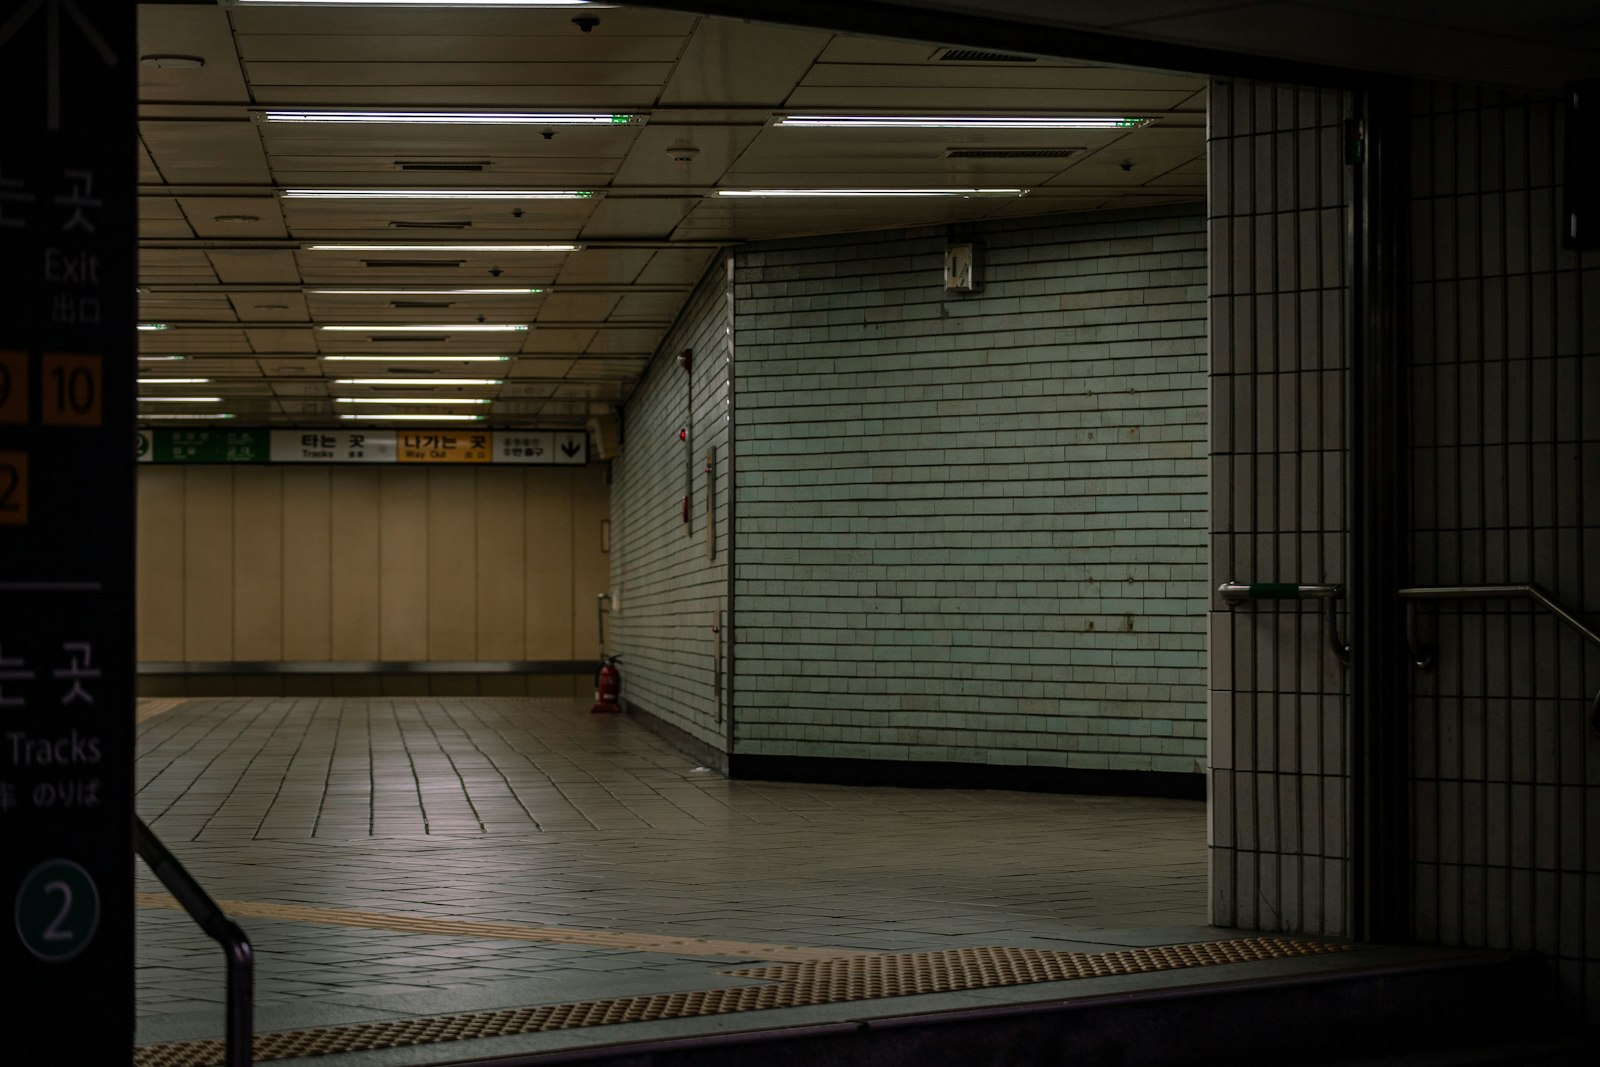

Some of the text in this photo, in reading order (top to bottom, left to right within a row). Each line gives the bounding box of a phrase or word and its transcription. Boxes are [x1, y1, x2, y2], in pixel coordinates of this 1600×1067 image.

[54, 168, 103, 233] 곳
[45, 247, 100, 284] Exit
[51, 367, 94, 413] 10
[301, 434, 365, 448] 타는 곳
[404, 435, 486, 449] 나가는 곳
[52, 641, 102, 706] 곳
[6, 728, 102, 767] Tracks
[42, 880, 74, 941] 2
